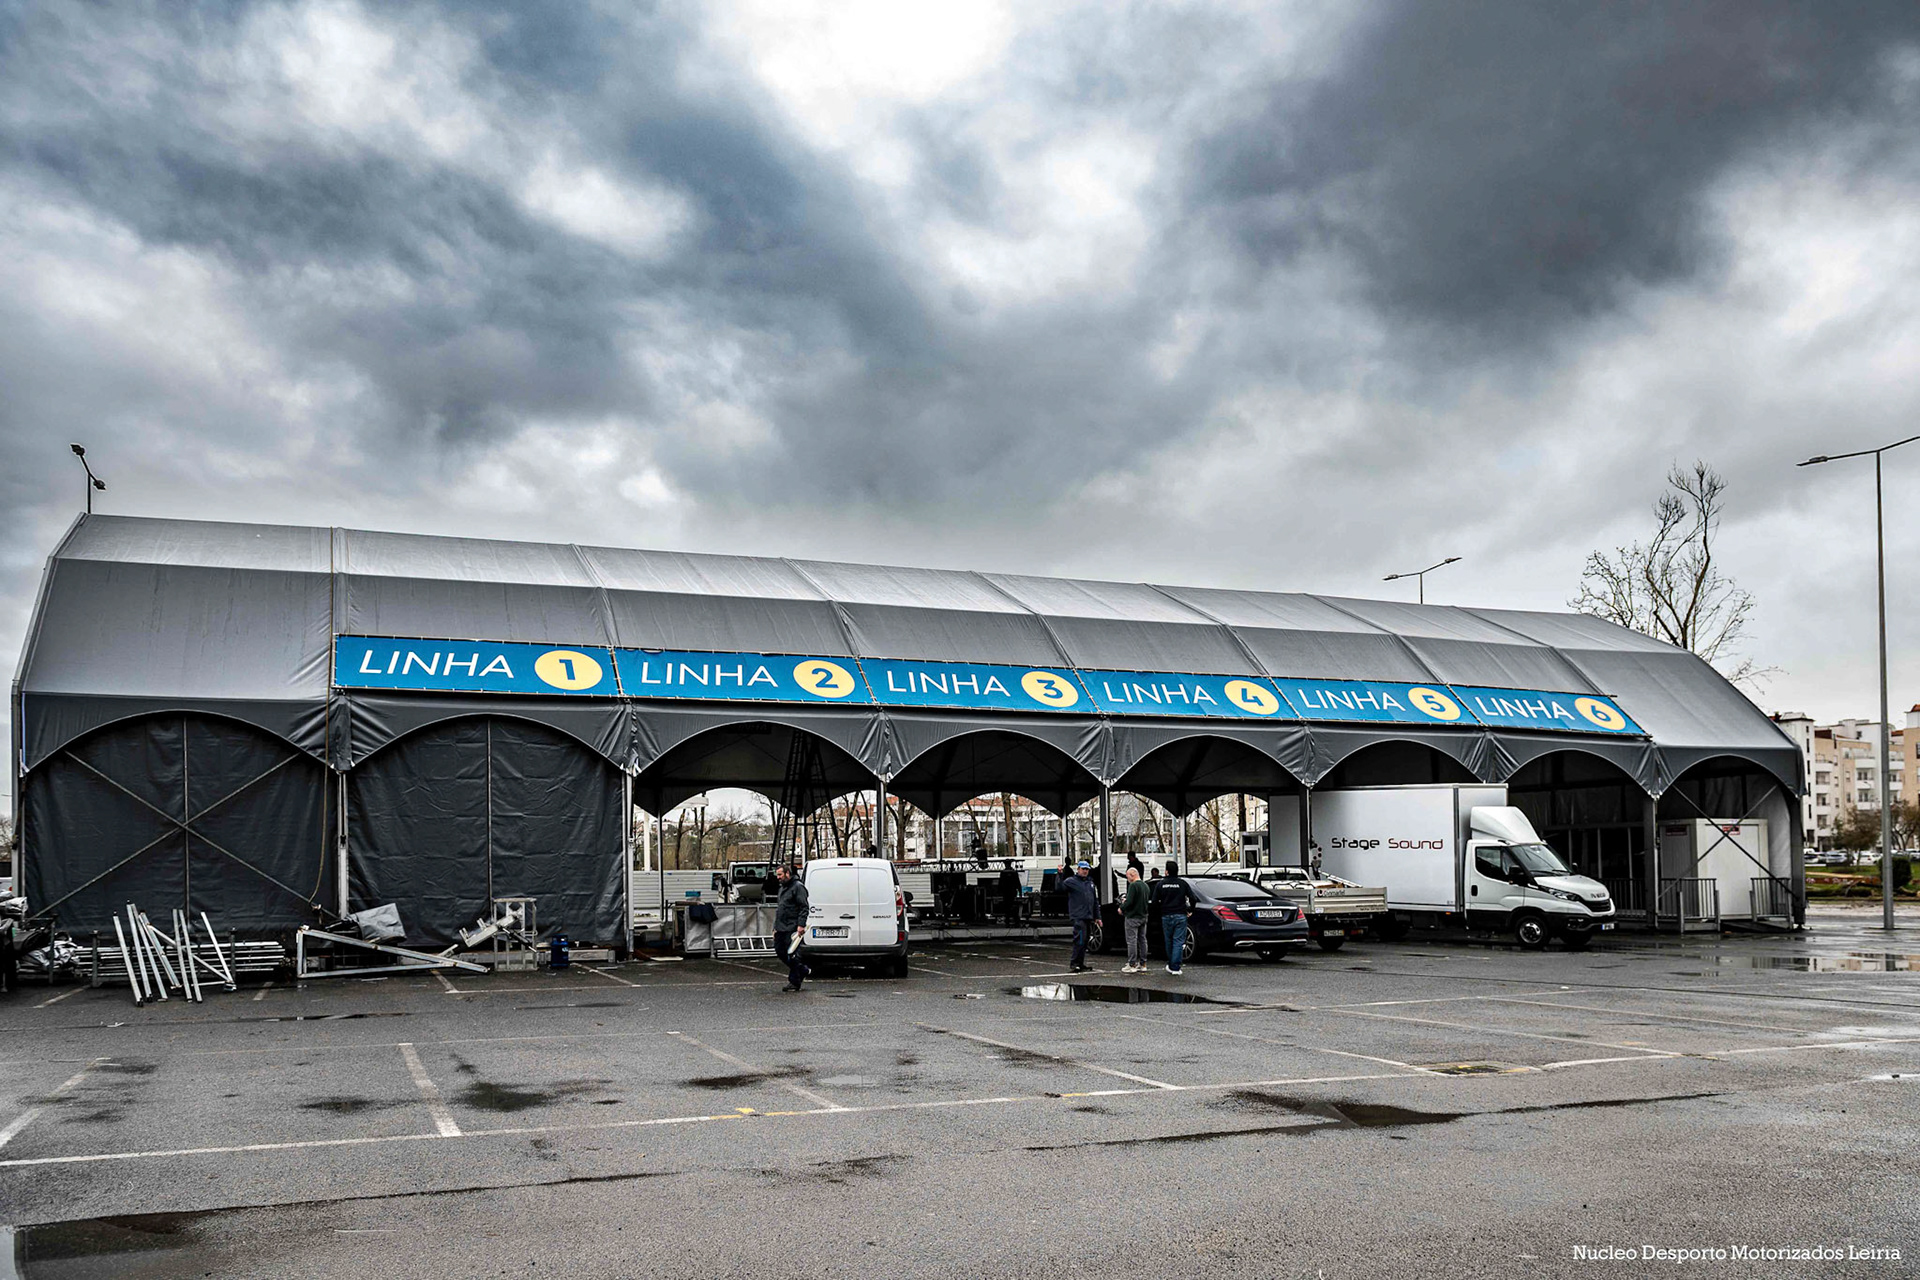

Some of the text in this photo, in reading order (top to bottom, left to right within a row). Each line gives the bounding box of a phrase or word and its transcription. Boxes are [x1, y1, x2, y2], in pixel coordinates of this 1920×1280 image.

[360, 650, 576, 680] LINHA 1
[641, 661, 839, 689] LINHA 2
[886, 671, 1063, 699] LINHA 3
[1104, 682, 1264, 707] LINHA 4
[1299, 689, 1446, 712] LINHA 5
[1475, 697, 1611, 722] LINHA 6
[1331, 837, 1443, 850] Stage Sound
